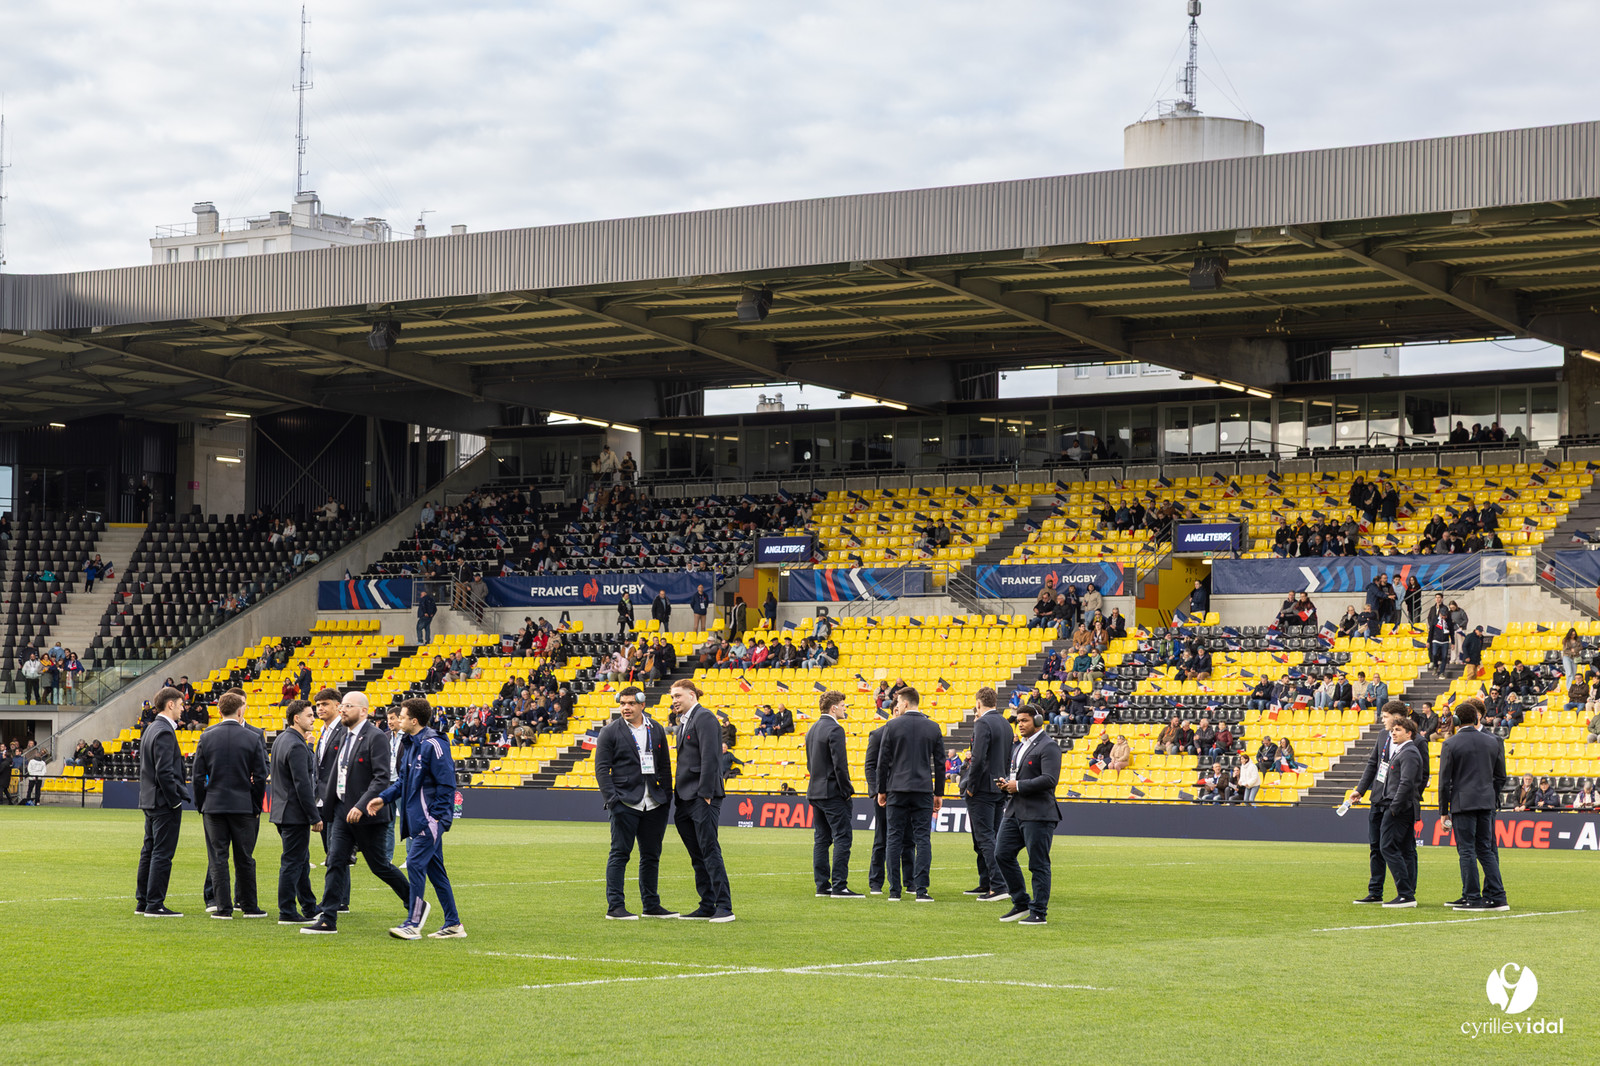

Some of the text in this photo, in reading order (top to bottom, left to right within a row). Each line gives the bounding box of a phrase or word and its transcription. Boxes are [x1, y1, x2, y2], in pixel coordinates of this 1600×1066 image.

[1001, 574, 1097, 585] FRANCE RUGBY
[530, 584, 645, 597] FRANCE RUGBY
[1432, 819, 1553, 849] FNCE
